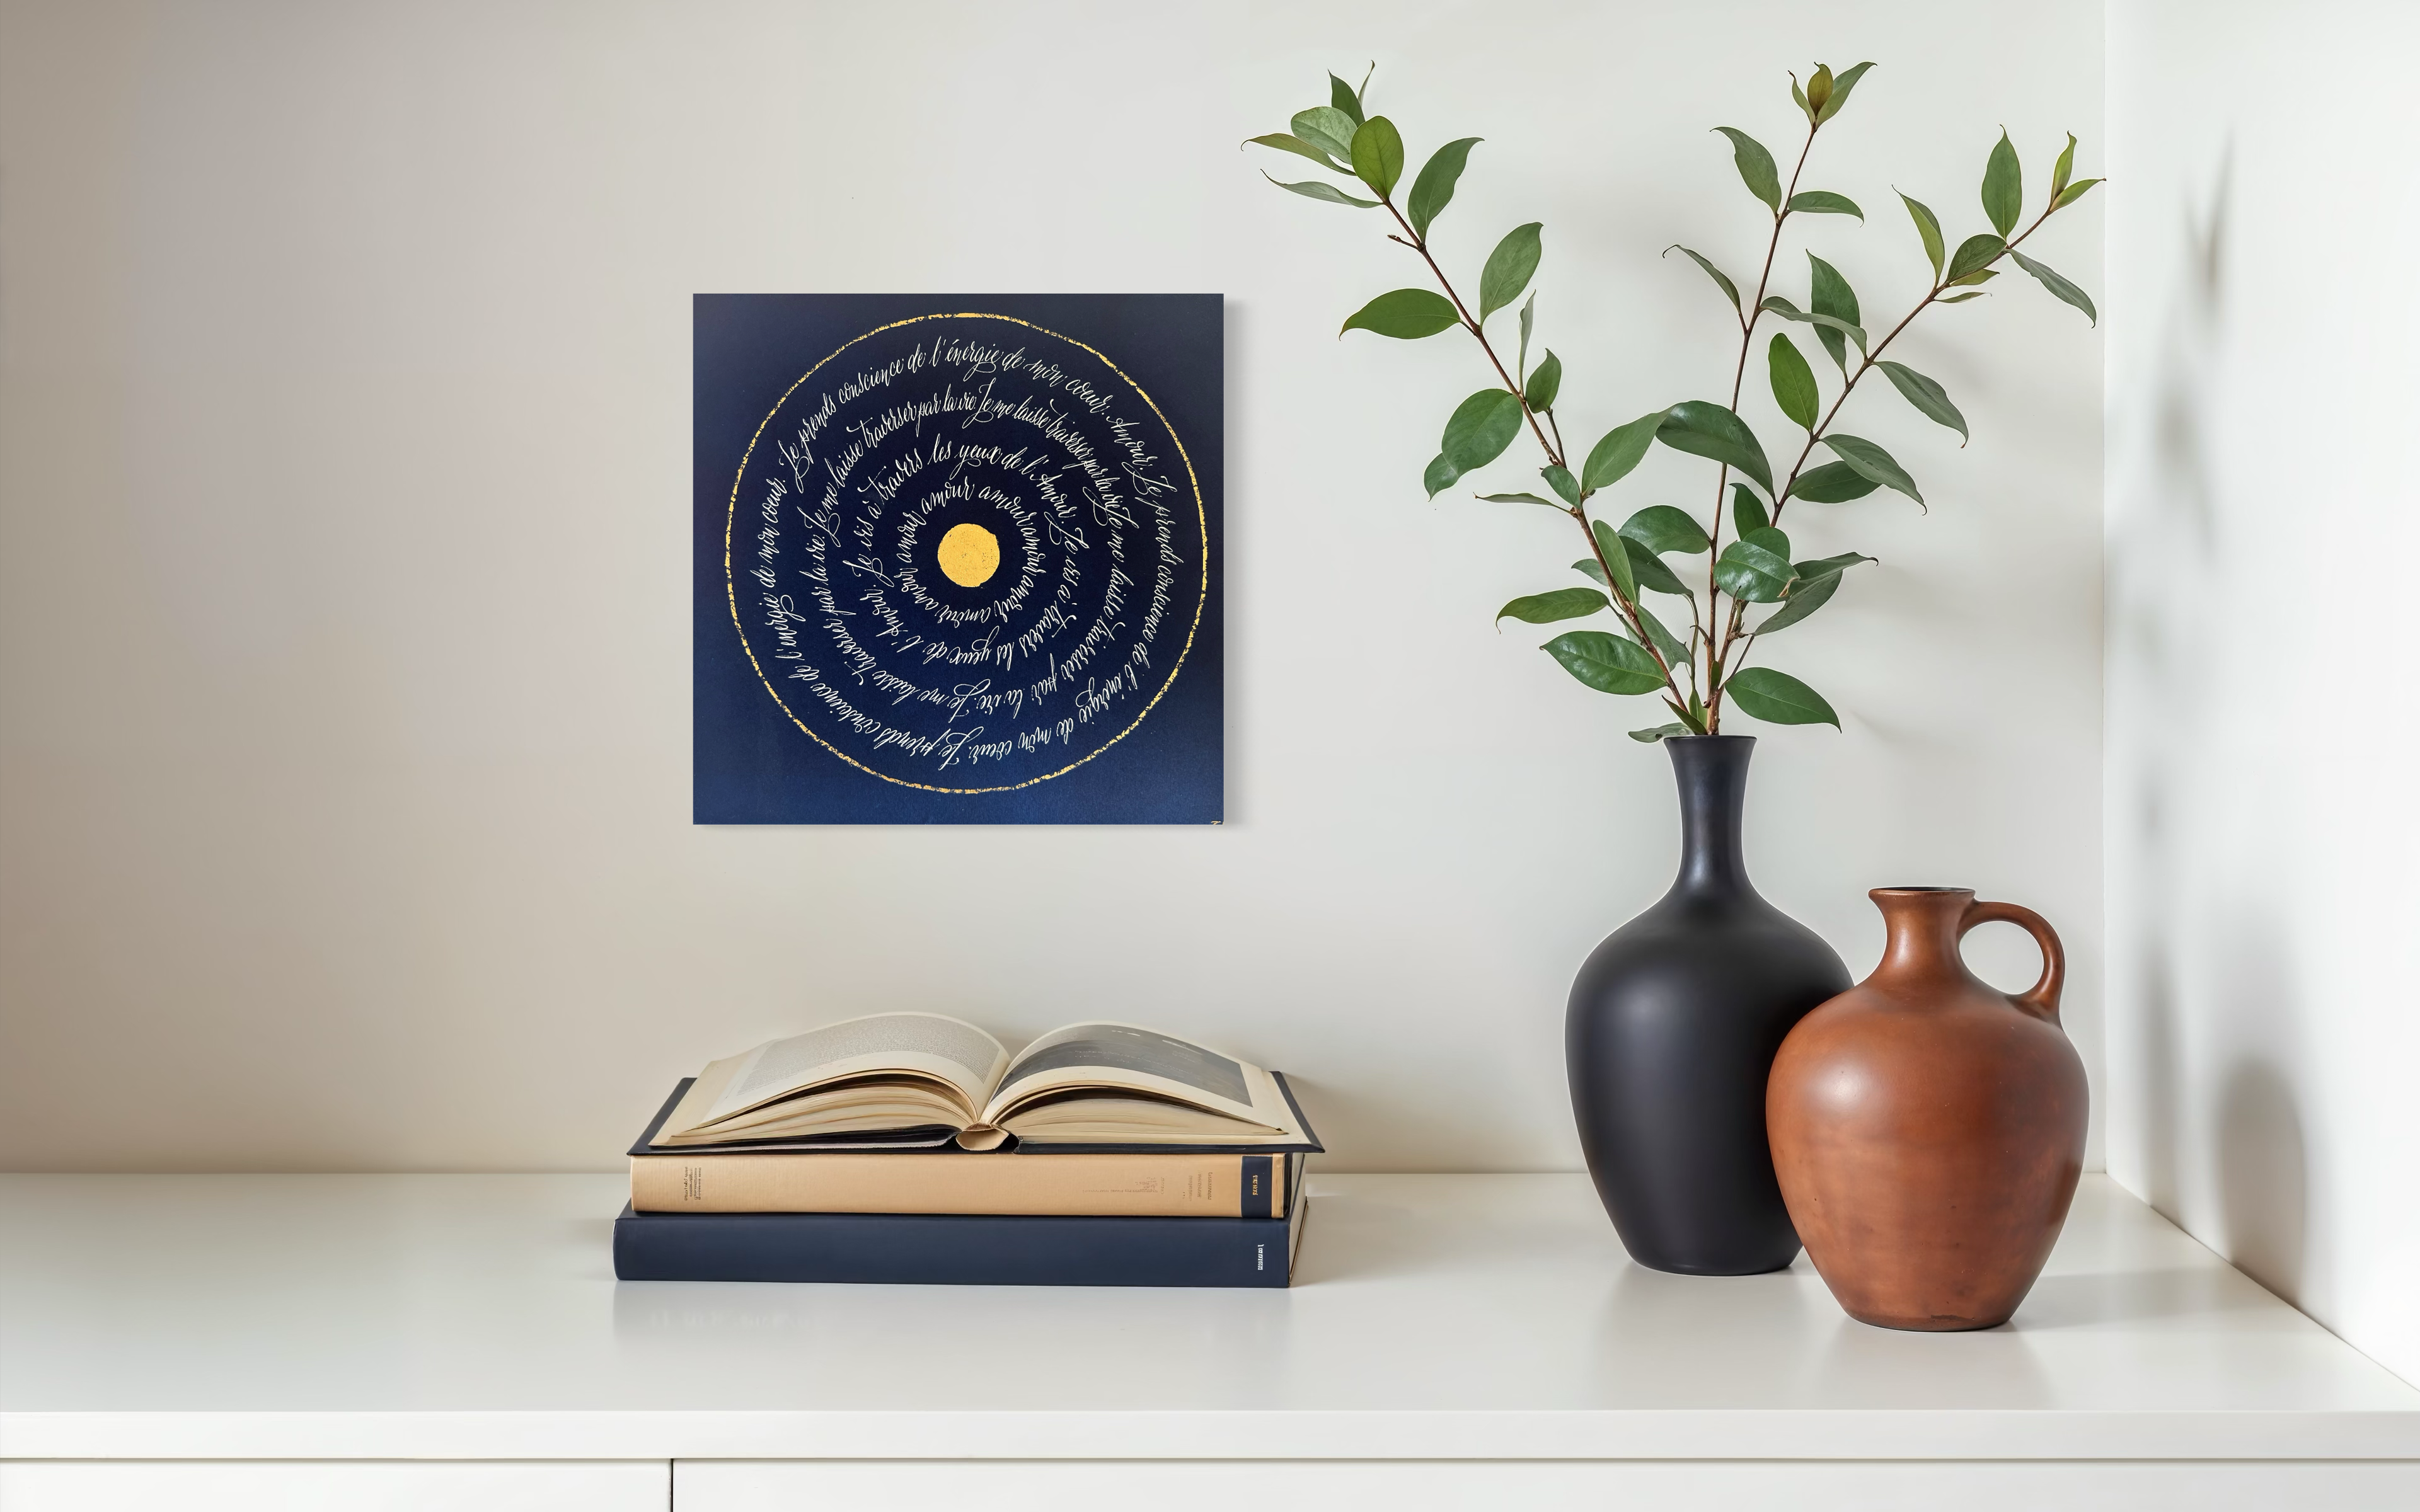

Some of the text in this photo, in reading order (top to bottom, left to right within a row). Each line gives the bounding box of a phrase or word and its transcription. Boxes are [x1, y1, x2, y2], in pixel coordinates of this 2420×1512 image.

[908, 343, 926, 374] de
[1001, 346, 1025, 371] de
[1023, 359, 1068, 387] mon
[838, 358, 904, 403] conscience
[942, 383, 957, 411] la
[915, 383, 950, 437] par
[961, 377, 996, 429] Je
[989, 399, 1016, 418] me
[1011, 395, 1068, 428] laisse
[798, 392, 836, 464] prends
[846, 401, 918, 448] traverser
[1045, 398, 1094, 462] traverser
[778, 439, 810, 493] Je
[824, 439, 863, 488] laisse
[927, 433, 952, 465] les
[948, 444, 1003, 480] yeux
[1001, 446, 1027, 469] de
[856, 447, 923, 505] travers
[1061, 459, 1120, 479] par
[1093, 478, 1120, 491] la
[1121, 456, 1177, 497] Je
[821, 481, 838, 510] me
[861, 500, 882, 518] à
[1082, 486, 1139, 529] Je
[757, 523, 780, 564] mon
[797, 506, 841, 547] Je
[853, 516, 873, 551] vis
[1043, 511, 1090, 554] Je
[1134, 496, 1184, 564] prends
[893, 476, 1046, 628] amour amour amour amour amour amour amour
[1107, 529, 1124, 562] me
[749, 564, 776, 588] de
[798, 562, 828, 585] la
[842, 553, 894, 587] Je
[1062, 555, 1080, 586] vis
[810, 586, 856, 616] par
[1057, 584, 1077, 605] à
[1103, 563, 1134, 619] laisse
[1142, 564, 1173, 642] conscience
[946, 625, 1000, 665] yeux
[1018, 600, 1076, 658] travers
[822, 618, 876, 685] traverser
[922, 641, 947, 665] de
[996, 641, 1015, 671] les
[1056, 615, 1126, 681] traverser
[1132, 642, 1150, 668] de
[788, 665, 819, 680] de
[872, 670, 920, 705] laisse
[1031, 653, 1057, 705] par
[810, 683, 880, 733] conscience
[916, 687, 949, 704] me
[947, 678, 991, 723] Je
[1003, 688, 1025, 719] la
[873, 728, 950, 757] prends
[938, 726, 984, 770] Je
[1017, 726, 1051, 753] mon
[1056, 718, 1073, 744] de
